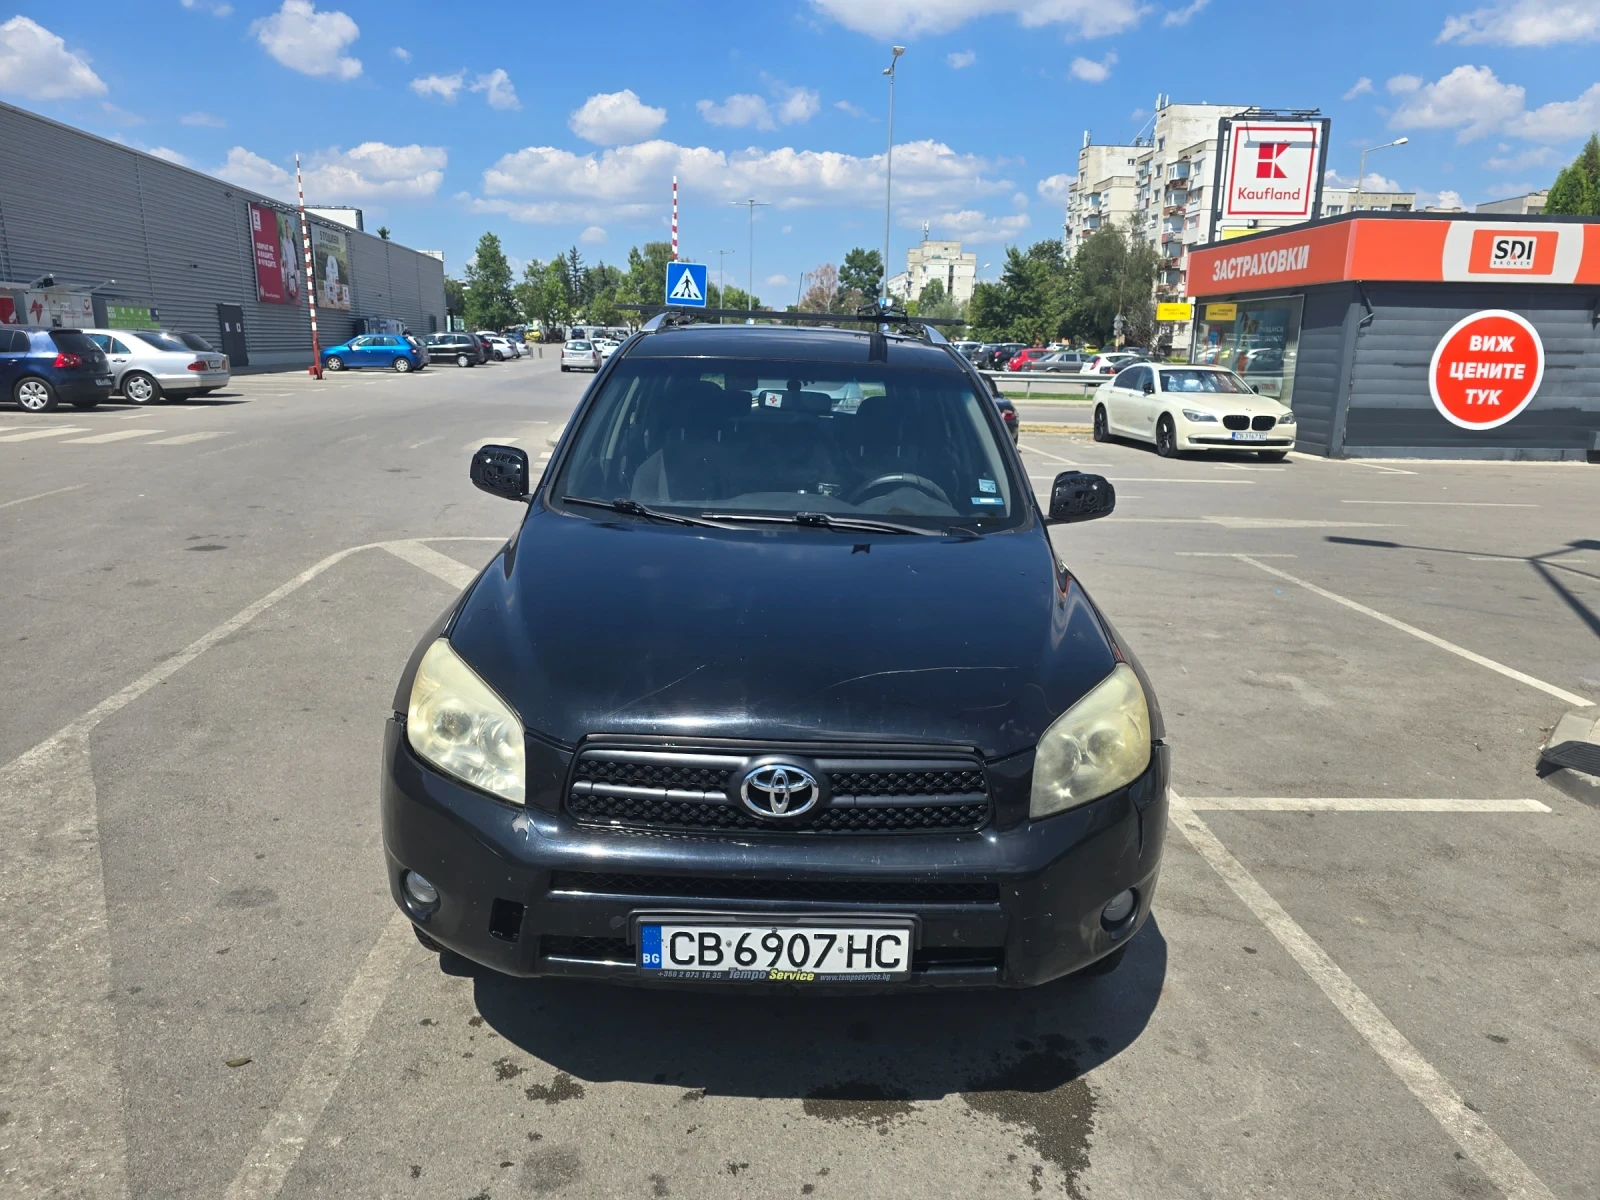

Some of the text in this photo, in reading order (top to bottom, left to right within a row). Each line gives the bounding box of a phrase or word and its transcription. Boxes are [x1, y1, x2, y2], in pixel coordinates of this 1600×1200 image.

[1238, 187, 1301, 200] Kaufland
[1494, 240, 1534, 259] SDI
[1212, 245, 1310, 281] ЗАСТРАХОВКИ
[1469, 335, 1515, 352] ВИЖ
[1449, 362, 1526, 381] ЦЕНИТЕ
[1465, 389, 1503, 405] ТУК
[642, 953, 660, 964] BG
[669, 931, 901, 969] CB 6907 HC
[728, 967, 766, 980] Tempo
[769, 968, 815, 981] Service
